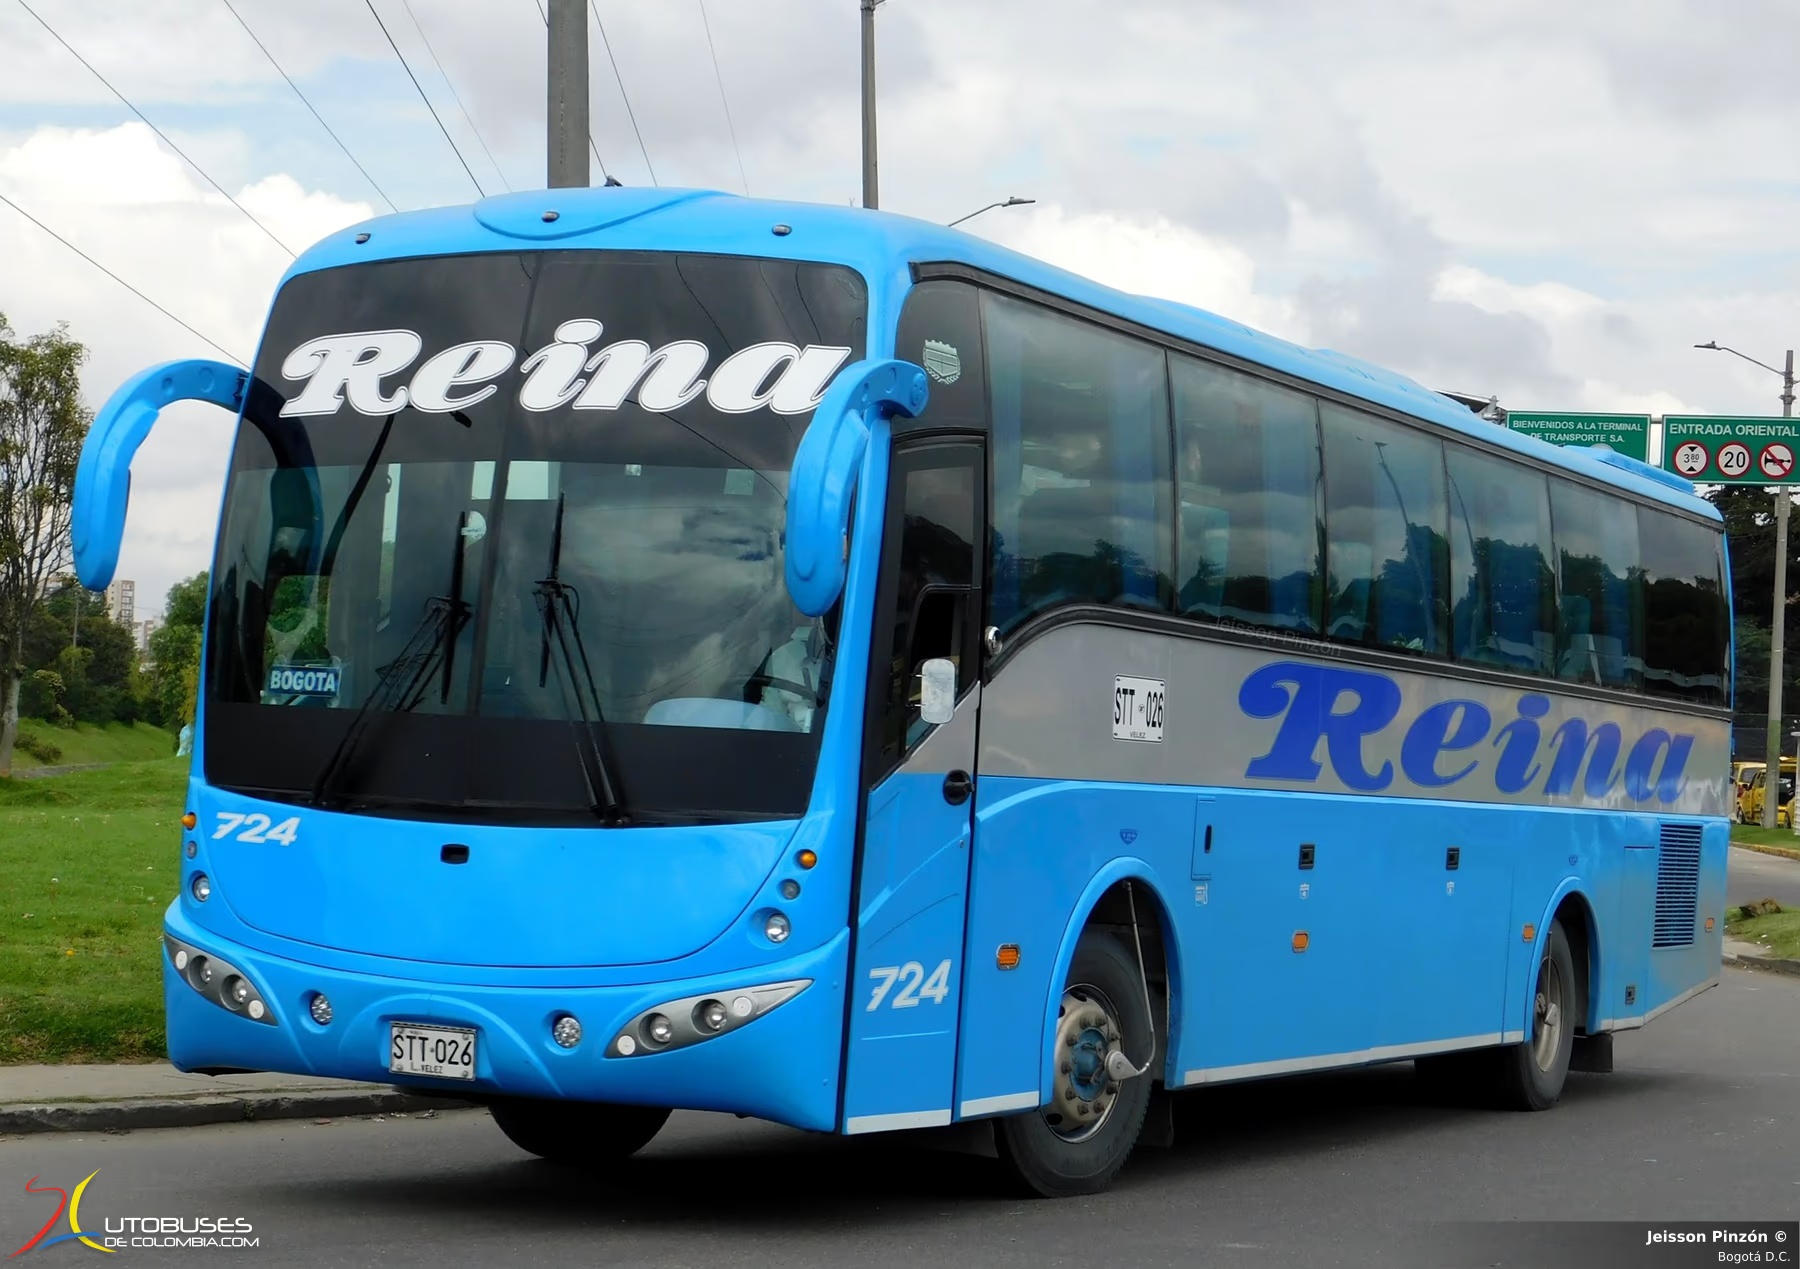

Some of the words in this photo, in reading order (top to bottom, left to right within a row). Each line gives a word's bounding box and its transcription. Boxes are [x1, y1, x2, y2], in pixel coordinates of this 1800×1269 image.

[279, 318, 852, 418] Reina
[1513, 420, 1574, 429] BIENVENIDOS
[1598, 423, 1642, 431] TERMINAL
[1669, 423, 1732, 435] ENTRADA
[1735, 425, 1799, 436] ORIENTAL
[1544, 433, 1606, 442] TRANSPORTE
[1723, 451, 1746, 468] 20
[270, 670, 336, 692] BOGOTA
[1129, 731, 1146, 739] VELEZ
[1238, 660, 1695, 803] Reina
[210, 811, 301, 847] 724
[865, 958, 952, 1012] 724
[421, 1064, 444, 1074] VELEZ
